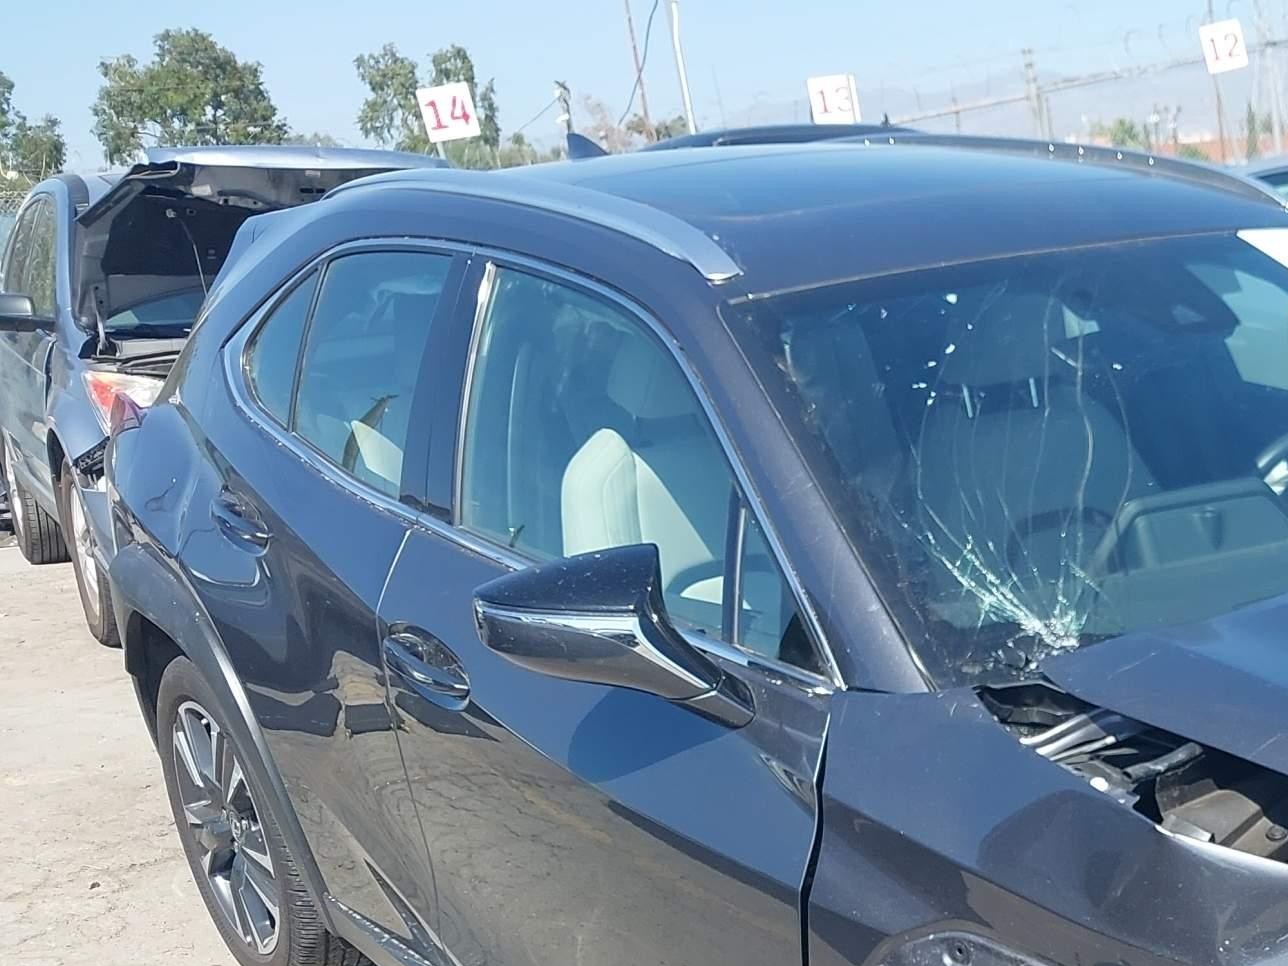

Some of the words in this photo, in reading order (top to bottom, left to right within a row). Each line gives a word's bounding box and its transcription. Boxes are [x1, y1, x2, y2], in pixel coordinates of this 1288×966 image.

[1209, 32, 1240, 60] 12
[424, 96, 470, 130] 14
[816, 86, 851, 114] 13
